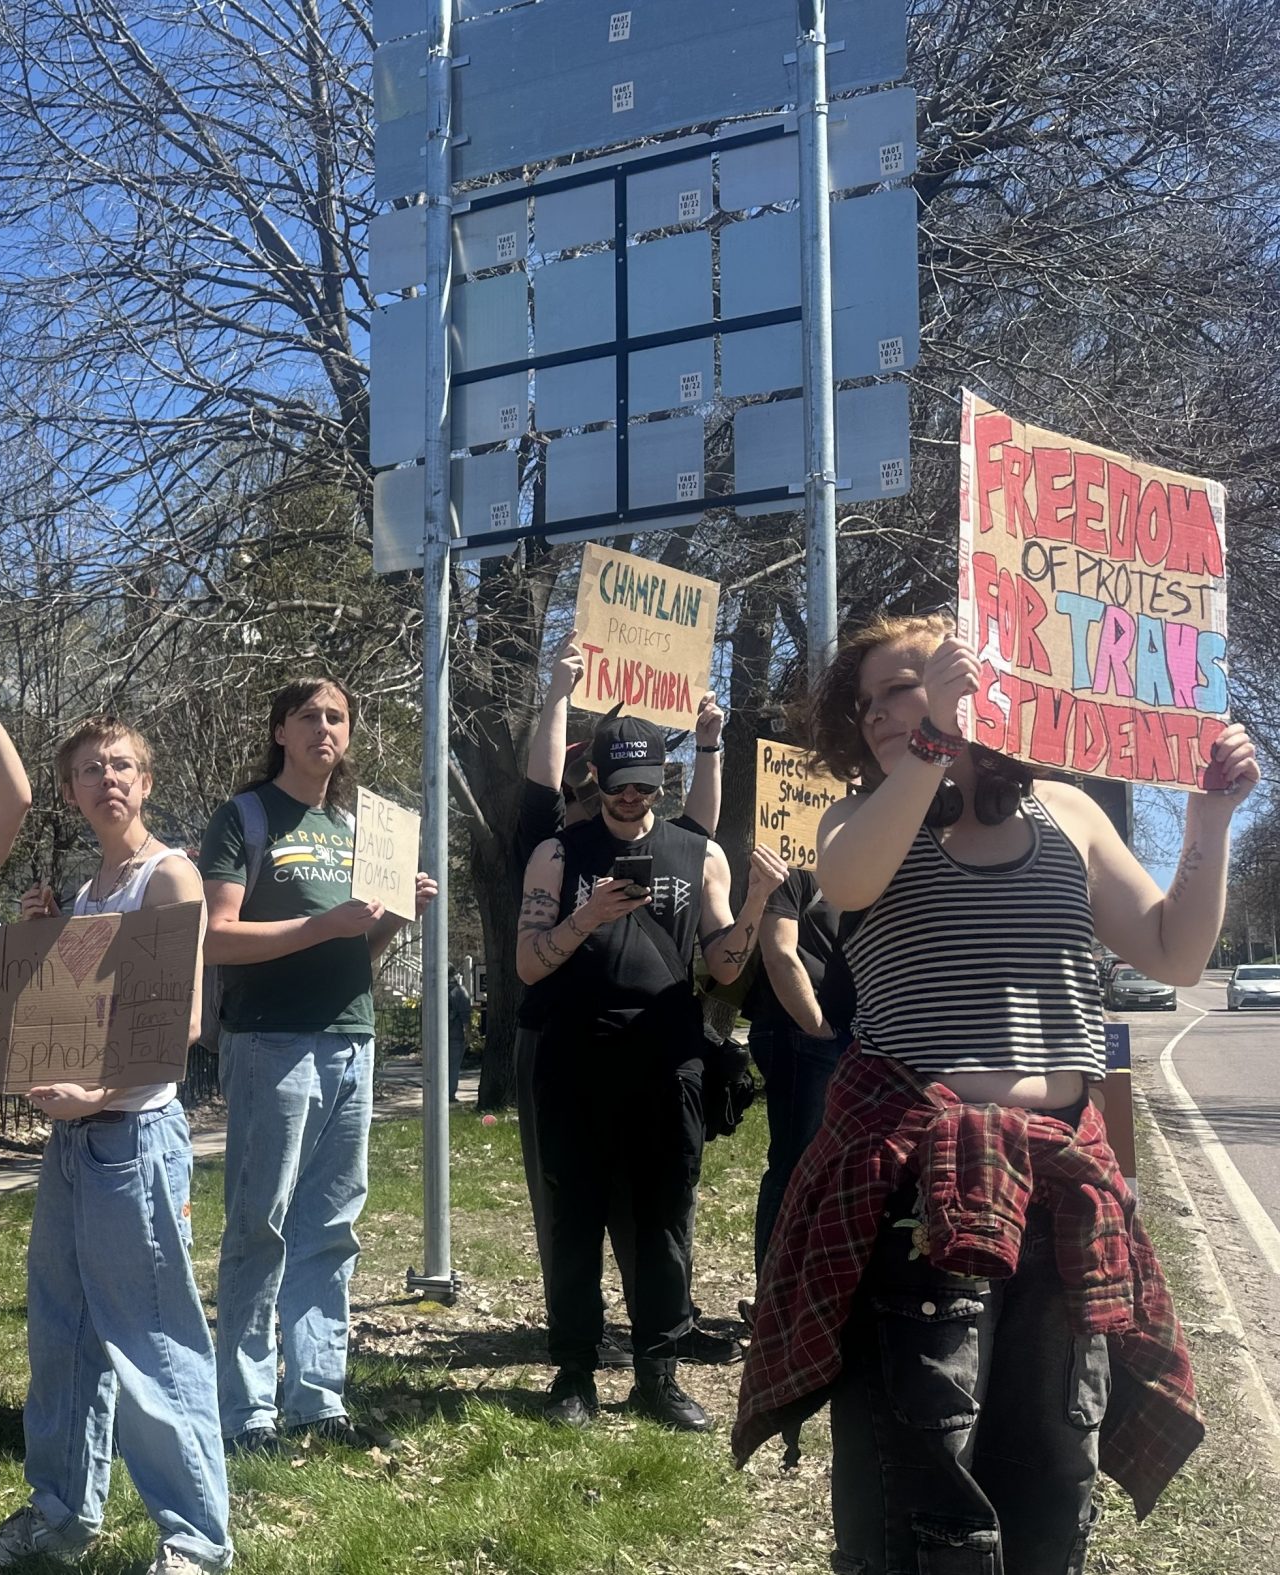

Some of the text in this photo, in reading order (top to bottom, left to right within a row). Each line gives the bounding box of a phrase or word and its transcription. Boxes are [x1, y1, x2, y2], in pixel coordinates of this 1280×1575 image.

[611, 22, 629, 31] 10/22
[613, 92, 632, 101] 10/22
[881, 153, 902, 163] 10/22
[680, 200, 699, 209] 10/22
[497, 242, 515, 251] 10/22
[880, 348, 902, 358] 10/22
[681, 382, 700, 391] 10/22
[500, 414, 518, 423] 10/22
[881, 469, 902, 478] 10/22
[678, 481, 697, 490] 10/22
[974, 412, 1223, 577] FREEDOM
[491, 511, 509, 520] 10/22
[1021, 540, 1068, 592] OF
[1075, 549, 1217, 620] PROTEST
[599, 559, 702, 628] CHAMPLAIN
[607, 617, 671, 653] PROTECTS
[972, 551, 1052, 676] FOR
[1056, 590, 1228, 714] TRANS
[582, 643, 693, 714] TRANSPHOBIA
[361, 793, 394, 833] FIRE
[760, 802, 791, 830] Not
[358, 826, 394, 860] DAVID
[357, 858, 401, 895] TOMASI
[120, 961, 193, 1017] Punishing
